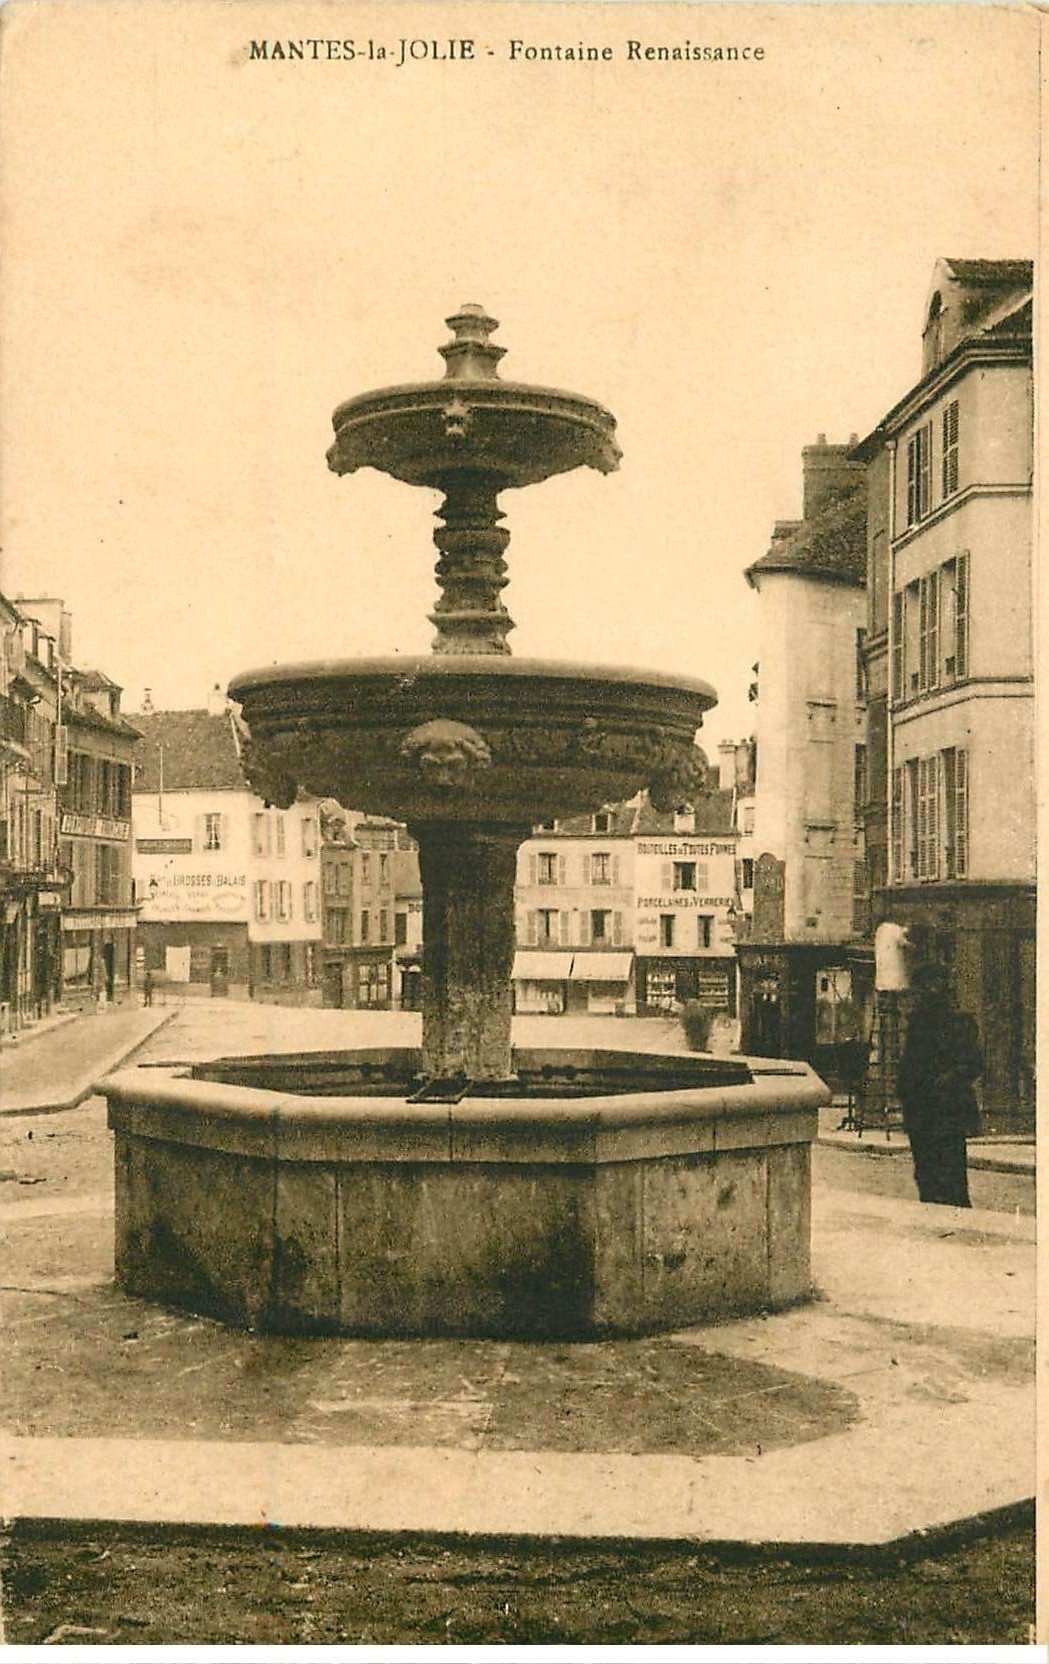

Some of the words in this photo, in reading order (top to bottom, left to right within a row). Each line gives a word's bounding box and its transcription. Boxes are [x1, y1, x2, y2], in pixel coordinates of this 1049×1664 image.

[173, 874, 212, 887] BROSSES
[215, 874, 246, 887] BALAIS
[637, 897, 689, 908] PORCELAINES
